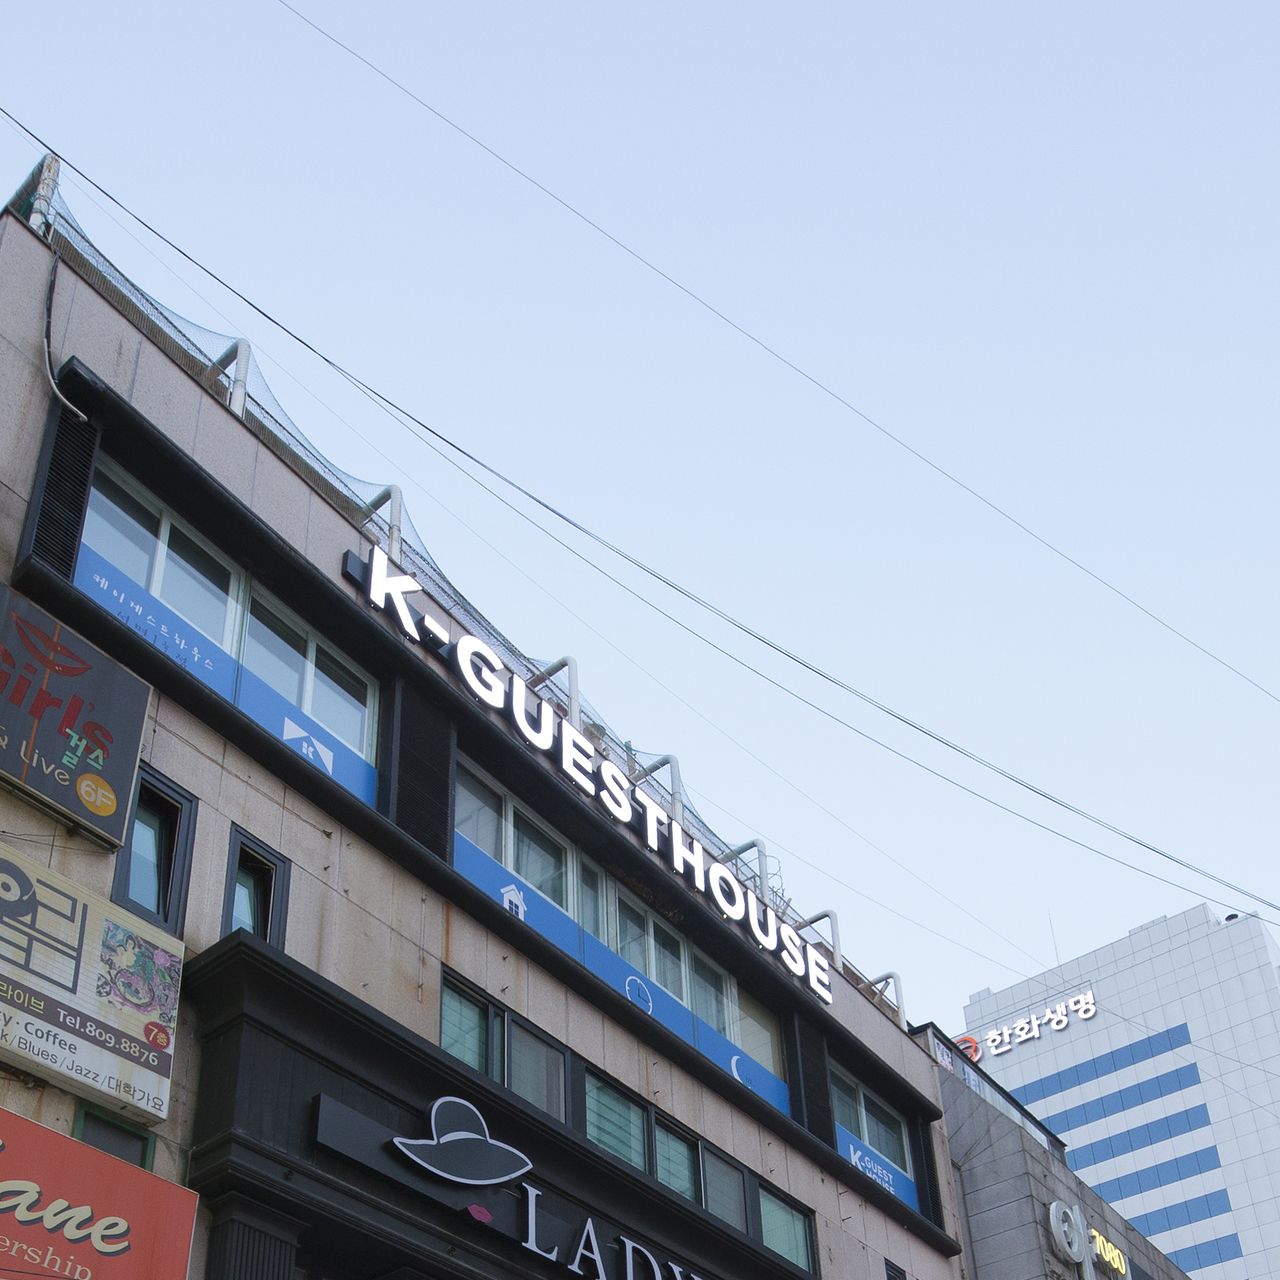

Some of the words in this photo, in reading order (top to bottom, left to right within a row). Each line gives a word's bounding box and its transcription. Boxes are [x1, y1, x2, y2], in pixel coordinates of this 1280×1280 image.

[20, 740, 71, 786] Live
[62, 727, 105, 770] 걸스
[79, 780, 118, 809] 6F
[370, 545, 833, 1006] K-GUESTHOUSE
[23, 1021, 78, 1056] Coffee
[56, 1007, 160, 1067] Tel.809.8876
[985, 989, 1097, 1056] 한화생명
[864, 1156, 893, 1185] GUEST
[1091, 1228, 1126, 1275] 7080
